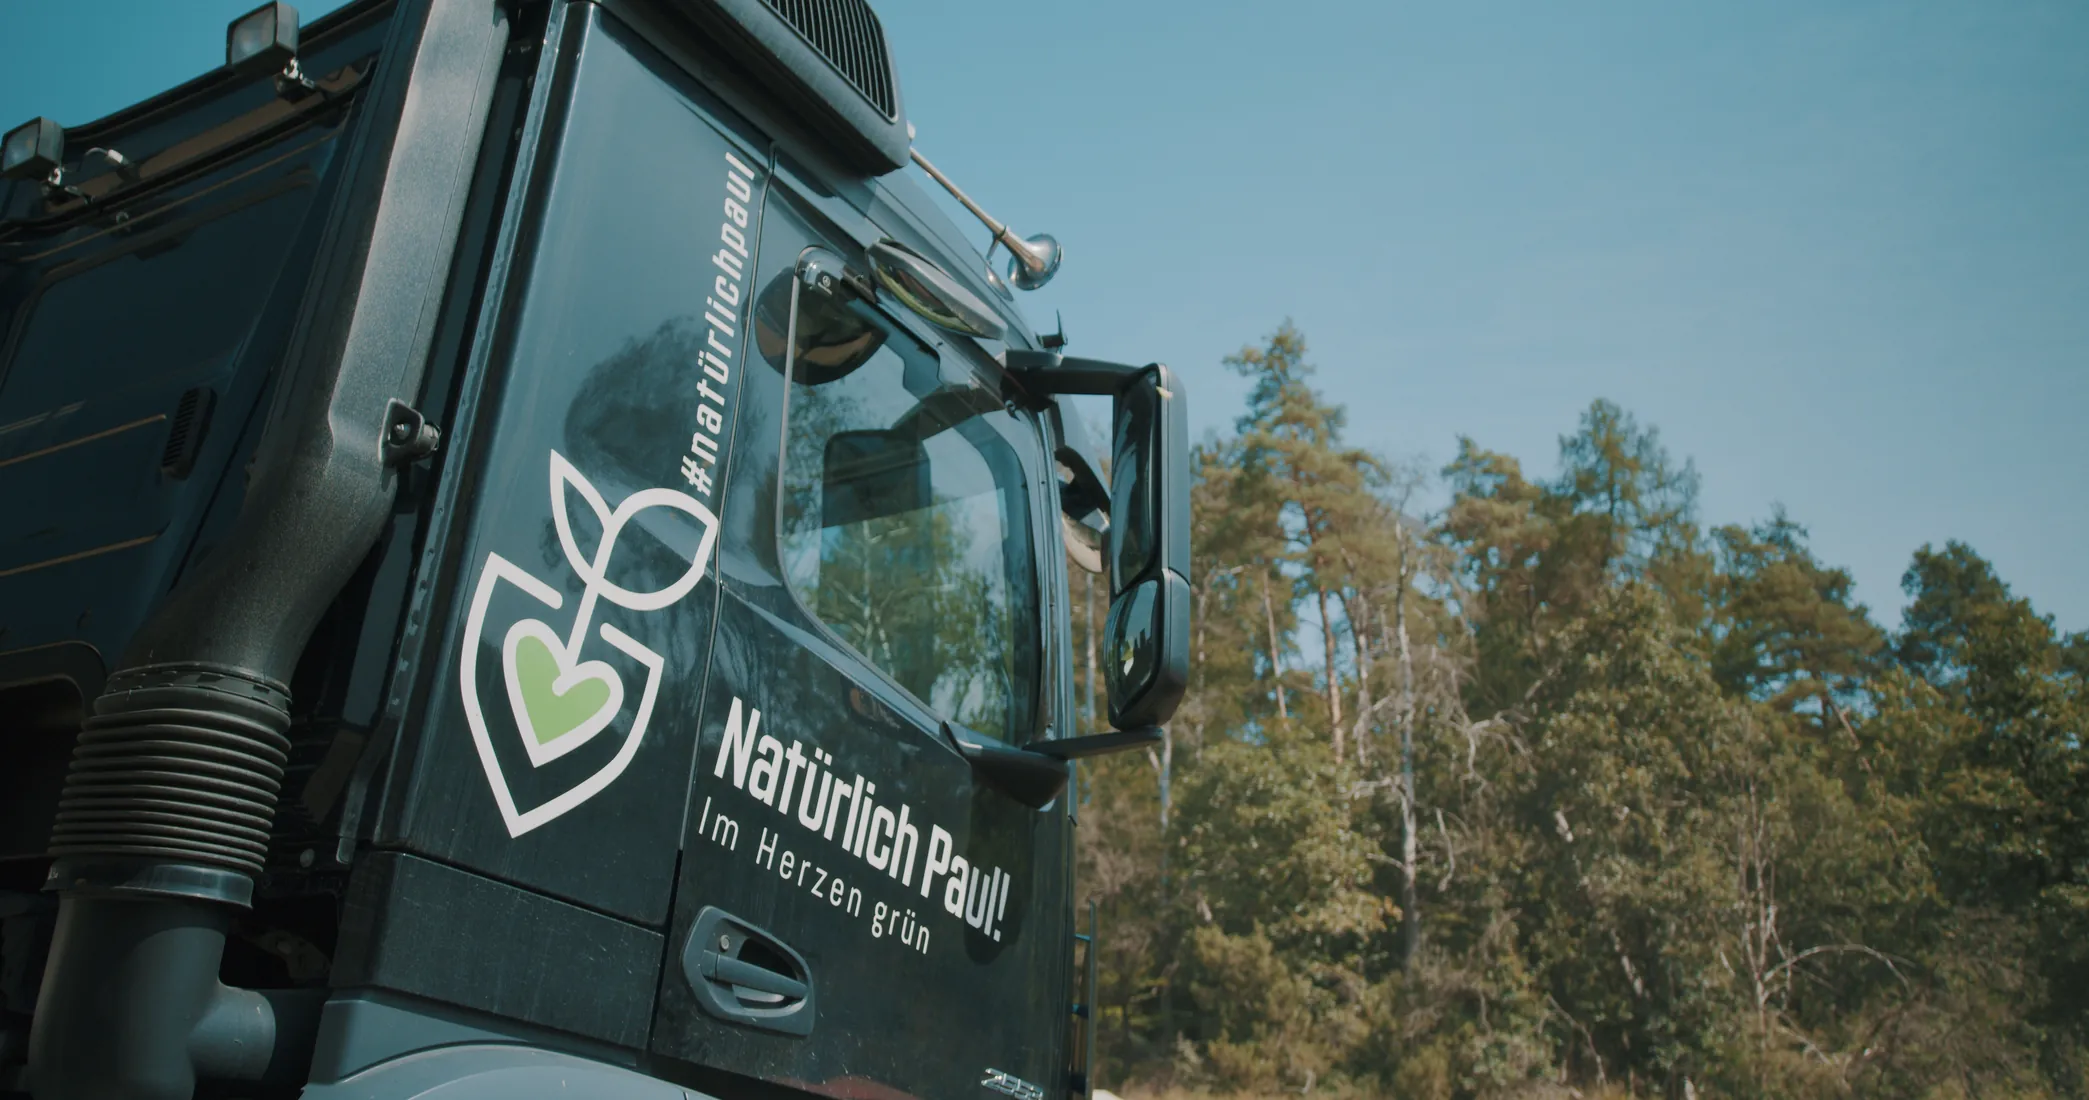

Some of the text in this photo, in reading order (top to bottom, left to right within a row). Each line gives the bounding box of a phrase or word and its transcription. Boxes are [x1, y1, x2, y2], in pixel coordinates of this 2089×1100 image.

[681, 152, 755, 497] #natürlichpaul
[698, 797, 930, 954] Im Herzen grün
[714, 696, 1010, 942] Natürlich Paul!
